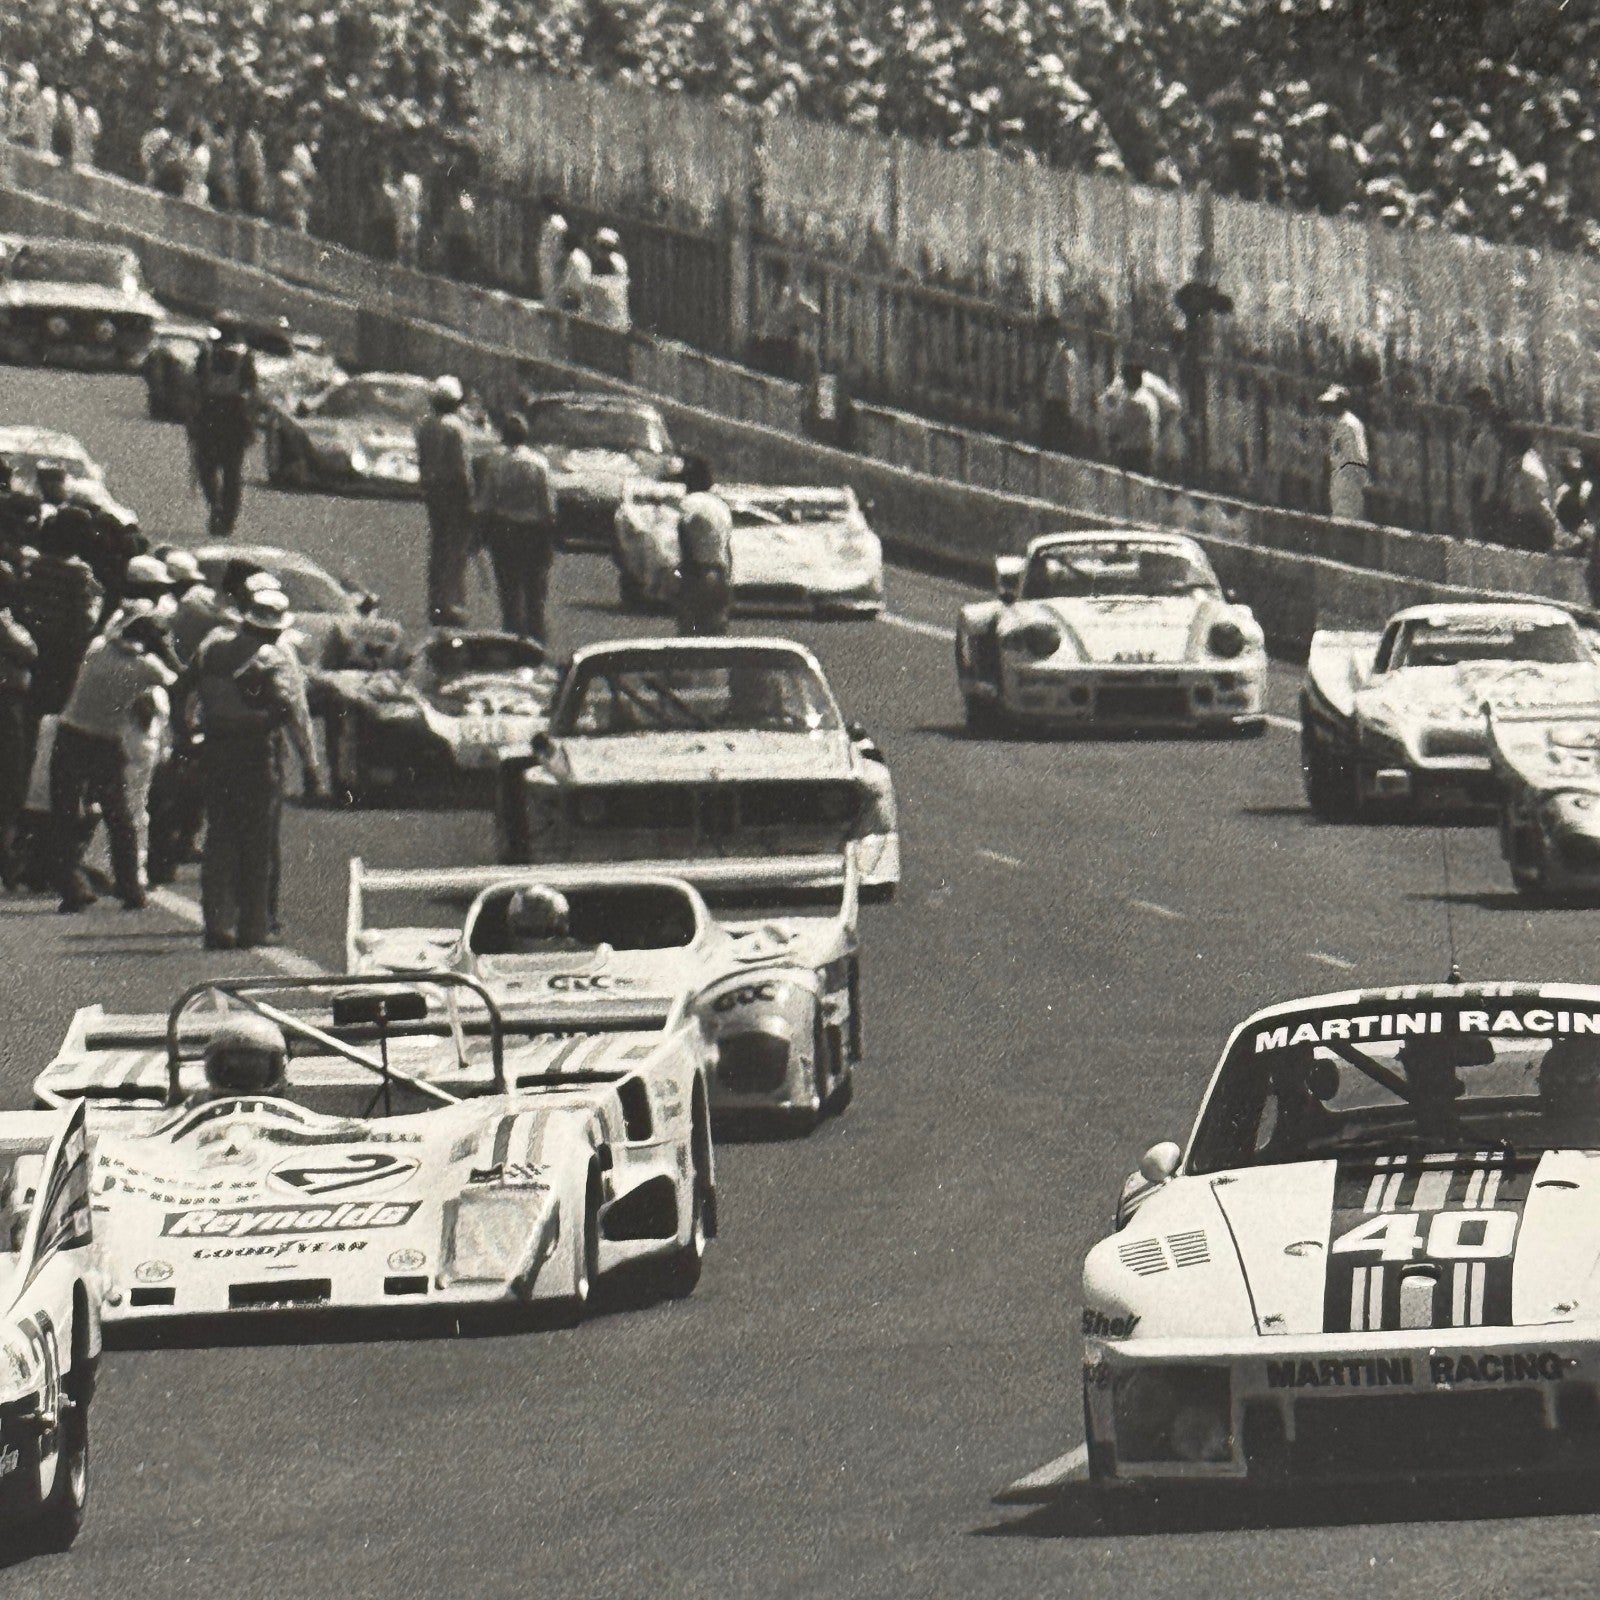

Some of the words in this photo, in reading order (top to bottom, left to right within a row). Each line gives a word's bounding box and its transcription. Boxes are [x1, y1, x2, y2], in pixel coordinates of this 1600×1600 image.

[1255, 1012, 1442, 1053] MARTINI
[167, 1202, 411, 1237] Reynolds
[1332, 1210, 1520, 1261] 40
[1266, 1357, 1415, 1388] MARTINI
[1428, 1351, 1565, 1386] RACING
